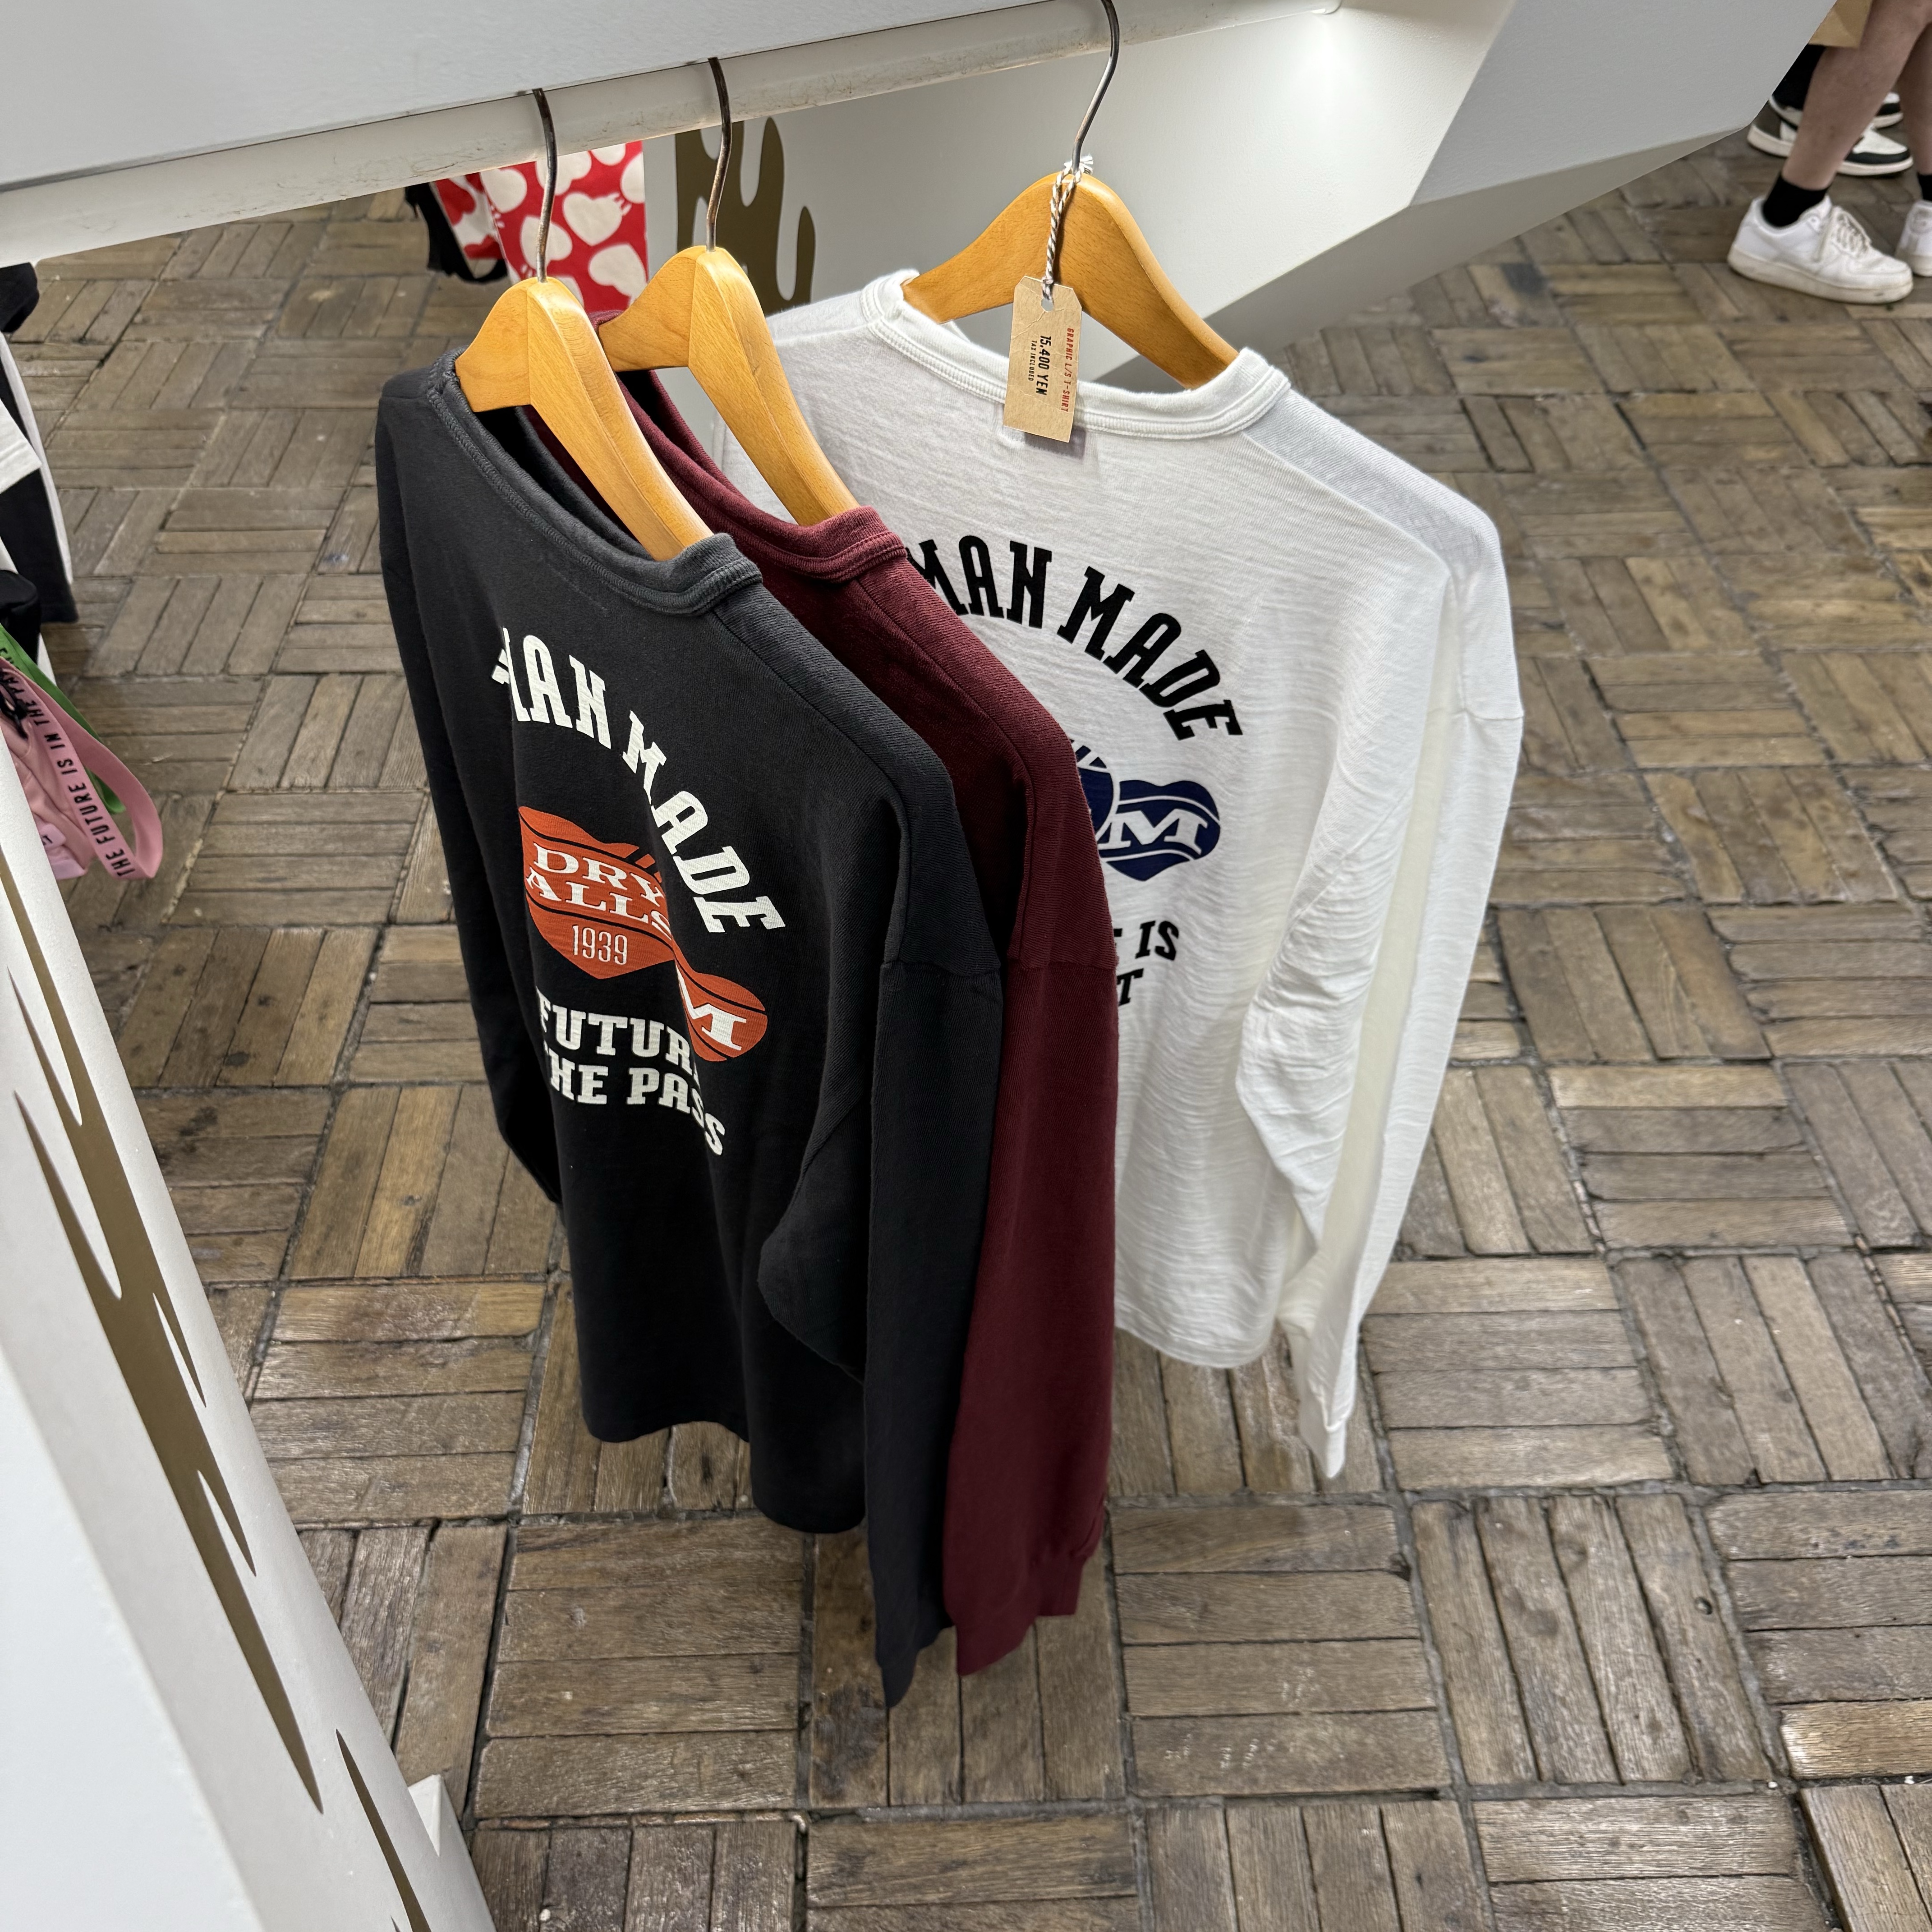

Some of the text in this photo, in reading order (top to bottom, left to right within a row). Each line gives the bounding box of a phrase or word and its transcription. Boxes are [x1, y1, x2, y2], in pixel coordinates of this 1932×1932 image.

[1028, 353, 1036, 382] INCLUDED
[1035, 375, 1049, 396] YEN
[1061, 328, 1074, 412] GRAPHIC L/S T-SHIRT
[1057, 566, 1243, 741] MADE
[44, 733, 65, 750] IN
[57, 759, 78, 774] IS
[68, 782, 115, 845] FUTURE
[106, 848, 136, 877] THE
[534, 842, 664, 907] DRY
[572, 925, 628, 965] 1939
[1135, 920, 1179, 961] IS
[536, 986, 700, 1087] FUTUR
[544, 1040, 609, 1105] HE
